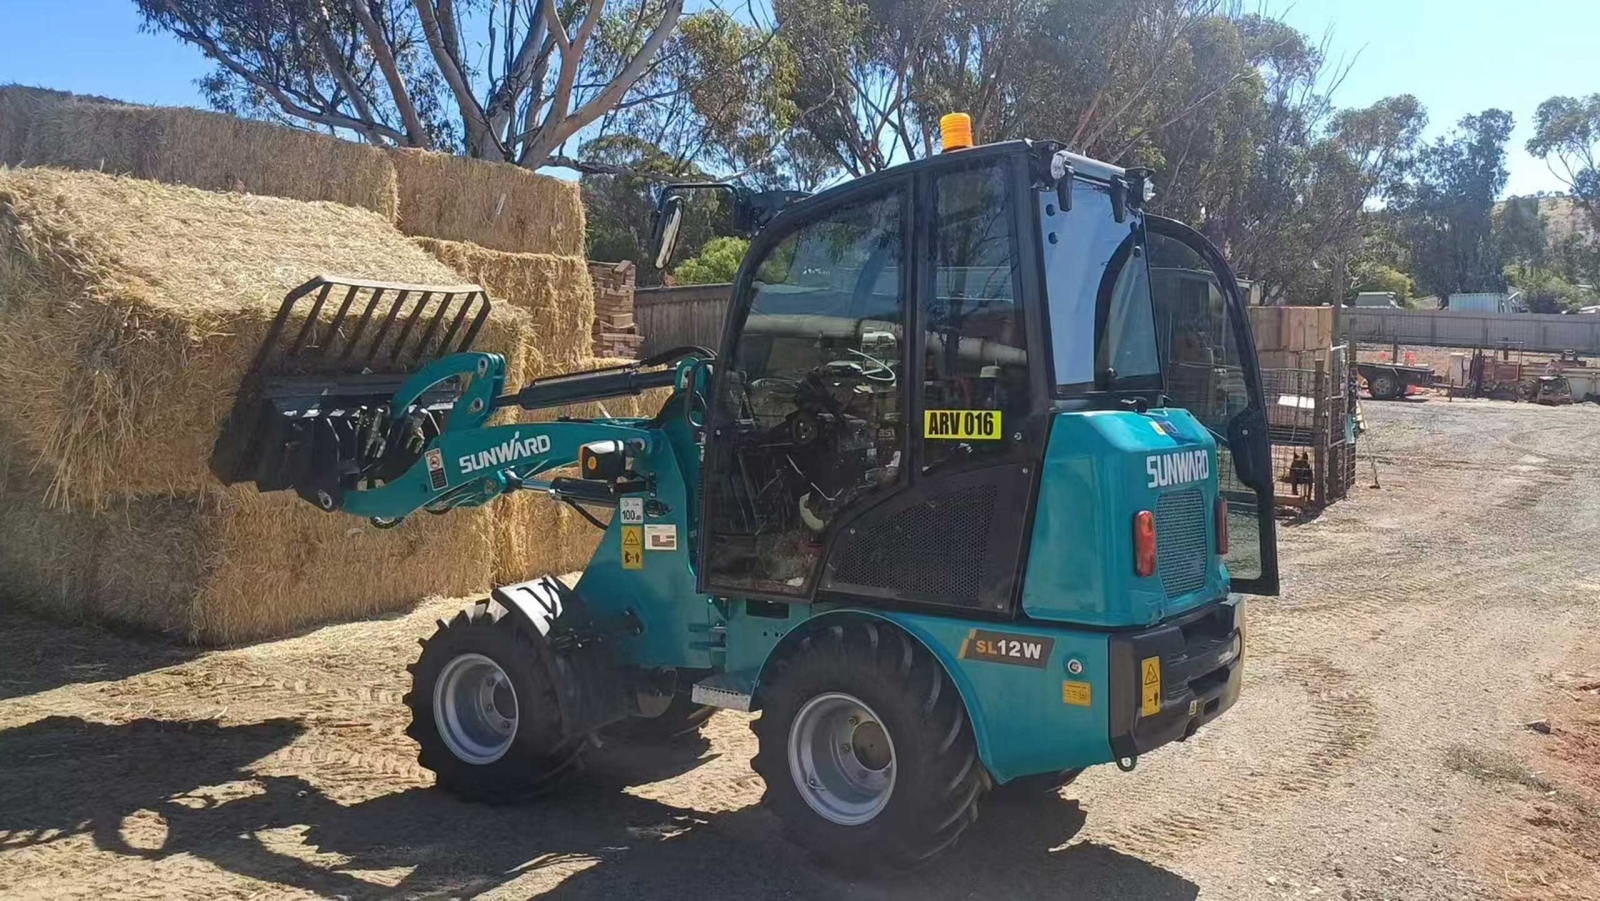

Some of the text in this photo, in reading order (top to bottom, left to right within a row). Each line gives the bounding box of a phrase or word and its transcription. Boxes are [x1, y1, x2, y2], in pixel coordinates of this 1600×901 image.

[929, 412, 994, 436] ARV 016
[459, 431, 551, 473] SUNWARD
[1146, 449, 1209, 488] SUNWARD
[622, 510, 635, 520] 100
[976, 640, 1041, 659] SL12W
